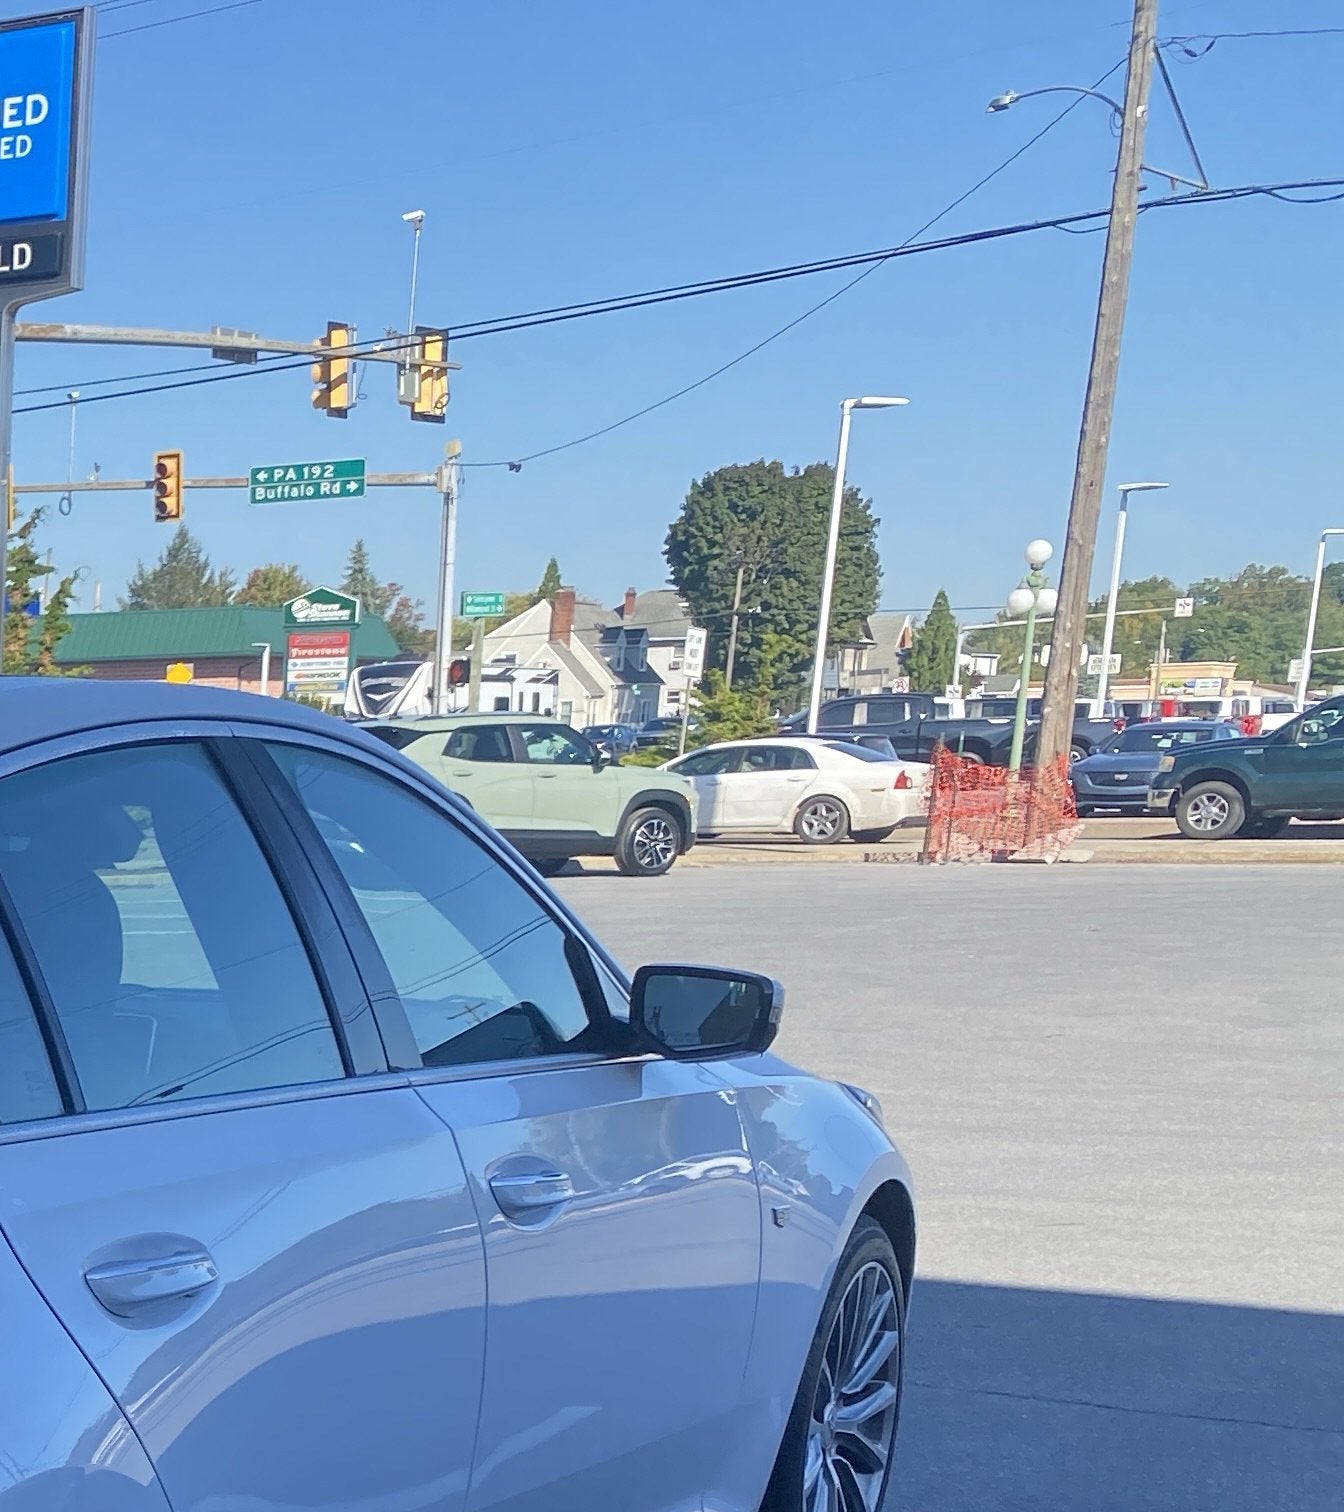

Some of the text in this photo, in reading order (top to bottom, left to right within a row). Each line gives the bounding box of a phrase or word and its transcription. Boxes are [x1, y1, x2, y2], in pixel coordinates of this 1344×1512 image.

[273, 465, 334, 482] PA 192
[255, 481, 340, 500] Buffalo Rd
